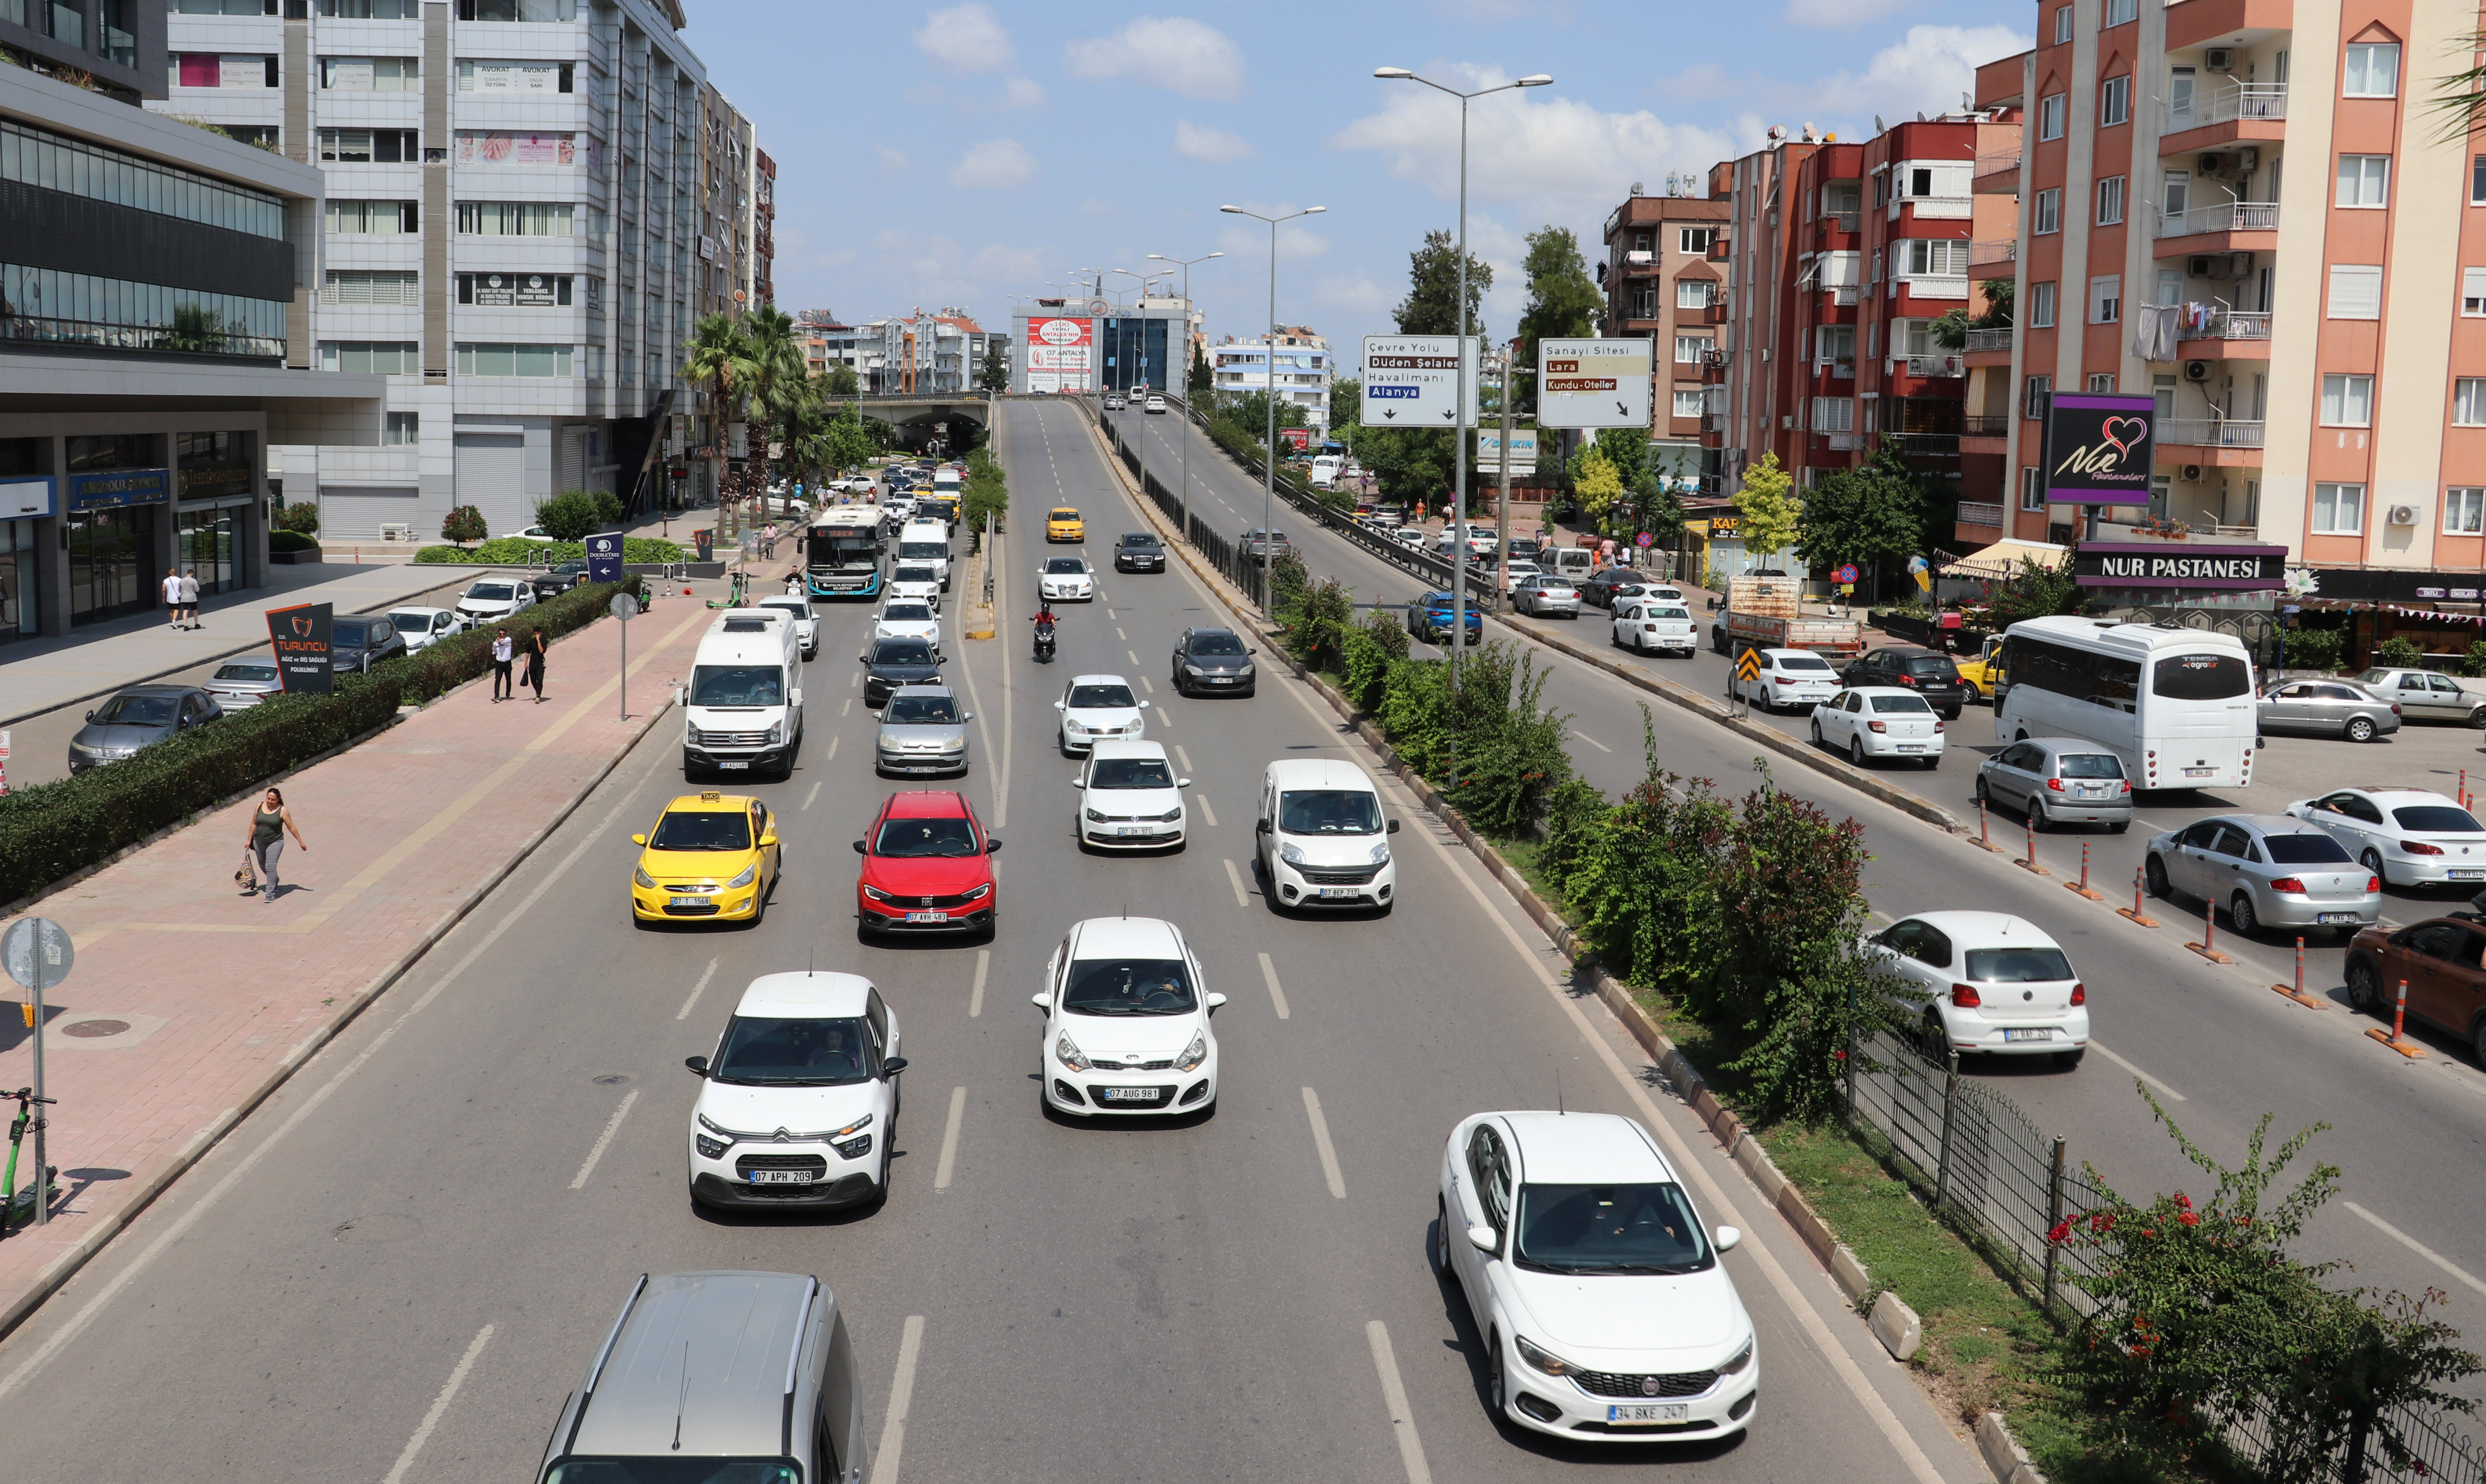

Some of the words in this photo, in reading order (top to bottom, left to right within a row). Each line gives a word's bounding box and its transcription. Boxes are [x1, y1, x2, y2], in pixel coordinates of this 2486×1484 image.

[1370, 343, 1407, 354] Çevre
[1411, 343, 1440, 352] Yolu
[1547, 347, 1588, 356] Sanayi
[1373, 357, 1412, 367] Düden
[1549, 363, 1576, 371] Lara
[1369, 373, 1444, 382] Havalimanı
[1548, 380, 1614, 389] Kundu-Oteller
[1372, 388, 1417, 397] Alanya
[2102, 557, 2144, 577] NUR
[2153, 556, 2261, 579] PASTANESİ
[278, 641, 327, 652] TURUNCU
[922, 897, 933, 906] FIAT
[1110, 1089, 1120, 1098] 07
[1123, 1089, 1139, 1098] AUG
[1142, 1089, 1157, 1098] 981
[756, 1172, 765, 1182] 07
[770, 1172, 787, 1182] APH
[793, 1172, 810, 1182] 209
[1616, 1407, 1629, 1419] 34
[1636, 1407, 1656, 1419] BKE
[1664, 1406, 1685, 1418] 247
